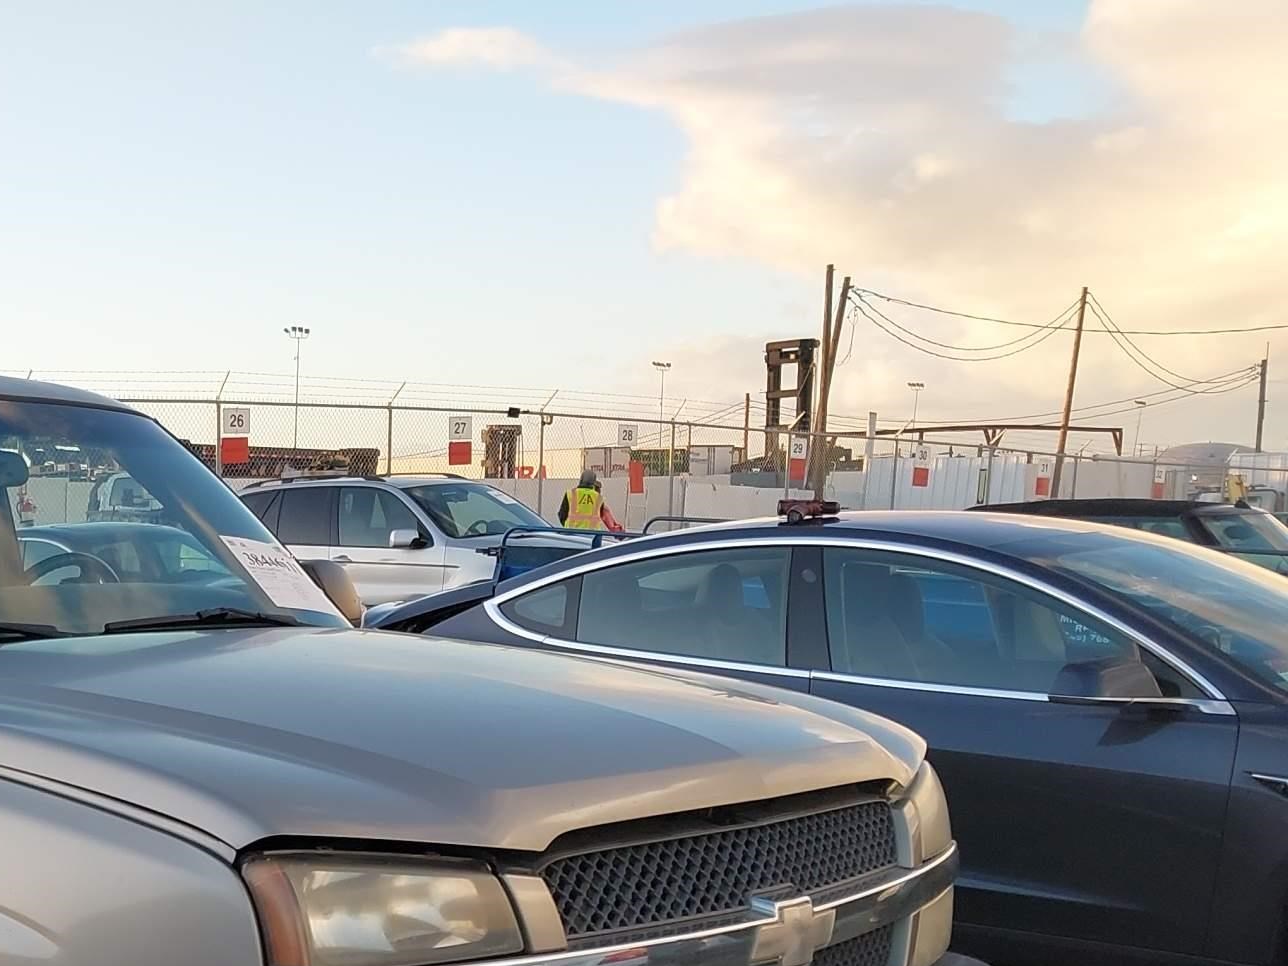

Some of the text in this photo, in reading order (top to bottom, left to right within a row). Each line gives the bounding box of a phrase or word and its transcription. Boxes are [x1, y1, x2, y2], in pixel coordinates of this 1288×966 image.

[229, 413, 244, 428] 26
[454, 422, 467, 434] 27
[622, 429, 633, 441] 28
[793, 443, 803, 454] 29
[919, 449, 928, 460] 30
